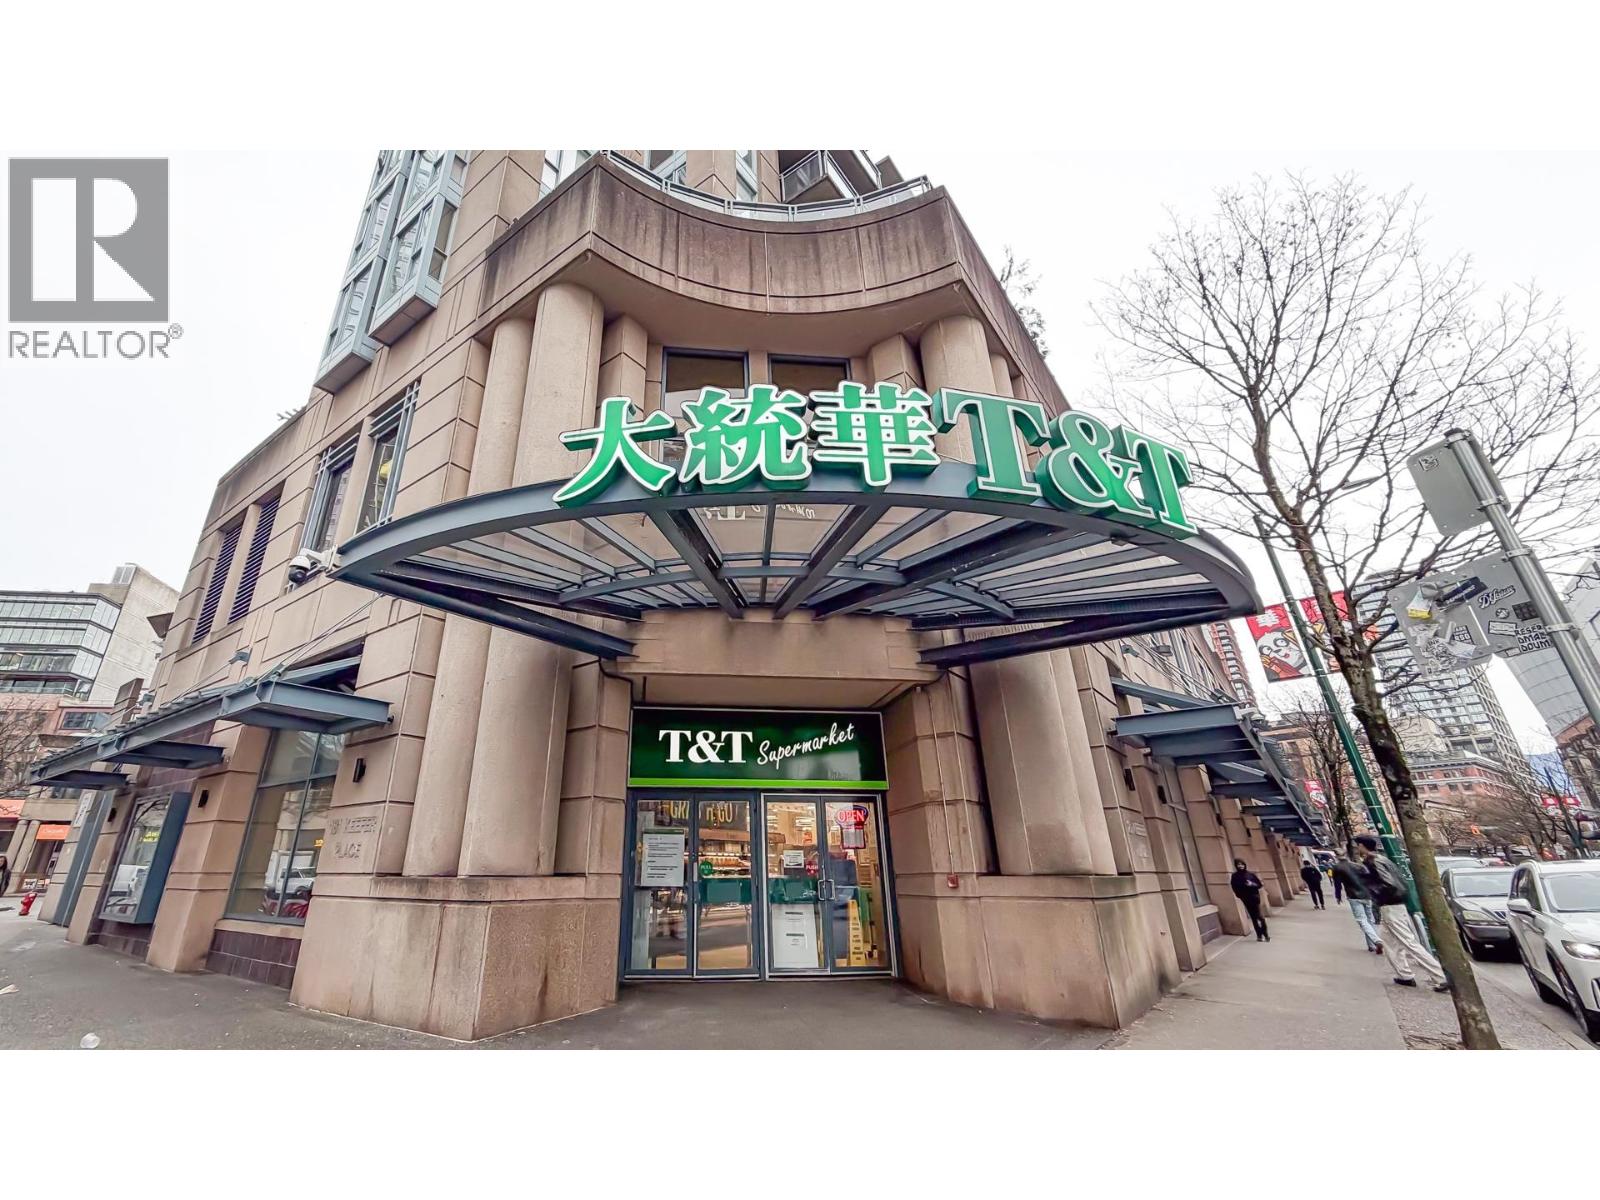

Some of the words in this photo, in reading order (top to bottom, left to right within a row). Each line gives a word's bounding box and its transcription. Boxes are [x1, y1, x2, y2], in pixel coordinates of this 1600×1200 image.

[552, 381, 941, 506] 大統華
[936, 387, 1199, 536] T&T
[658, 729, 754, 763] T&T
[757, 722, 855, 769] Supermarket
[837, 810, 865, 822] OPEN
